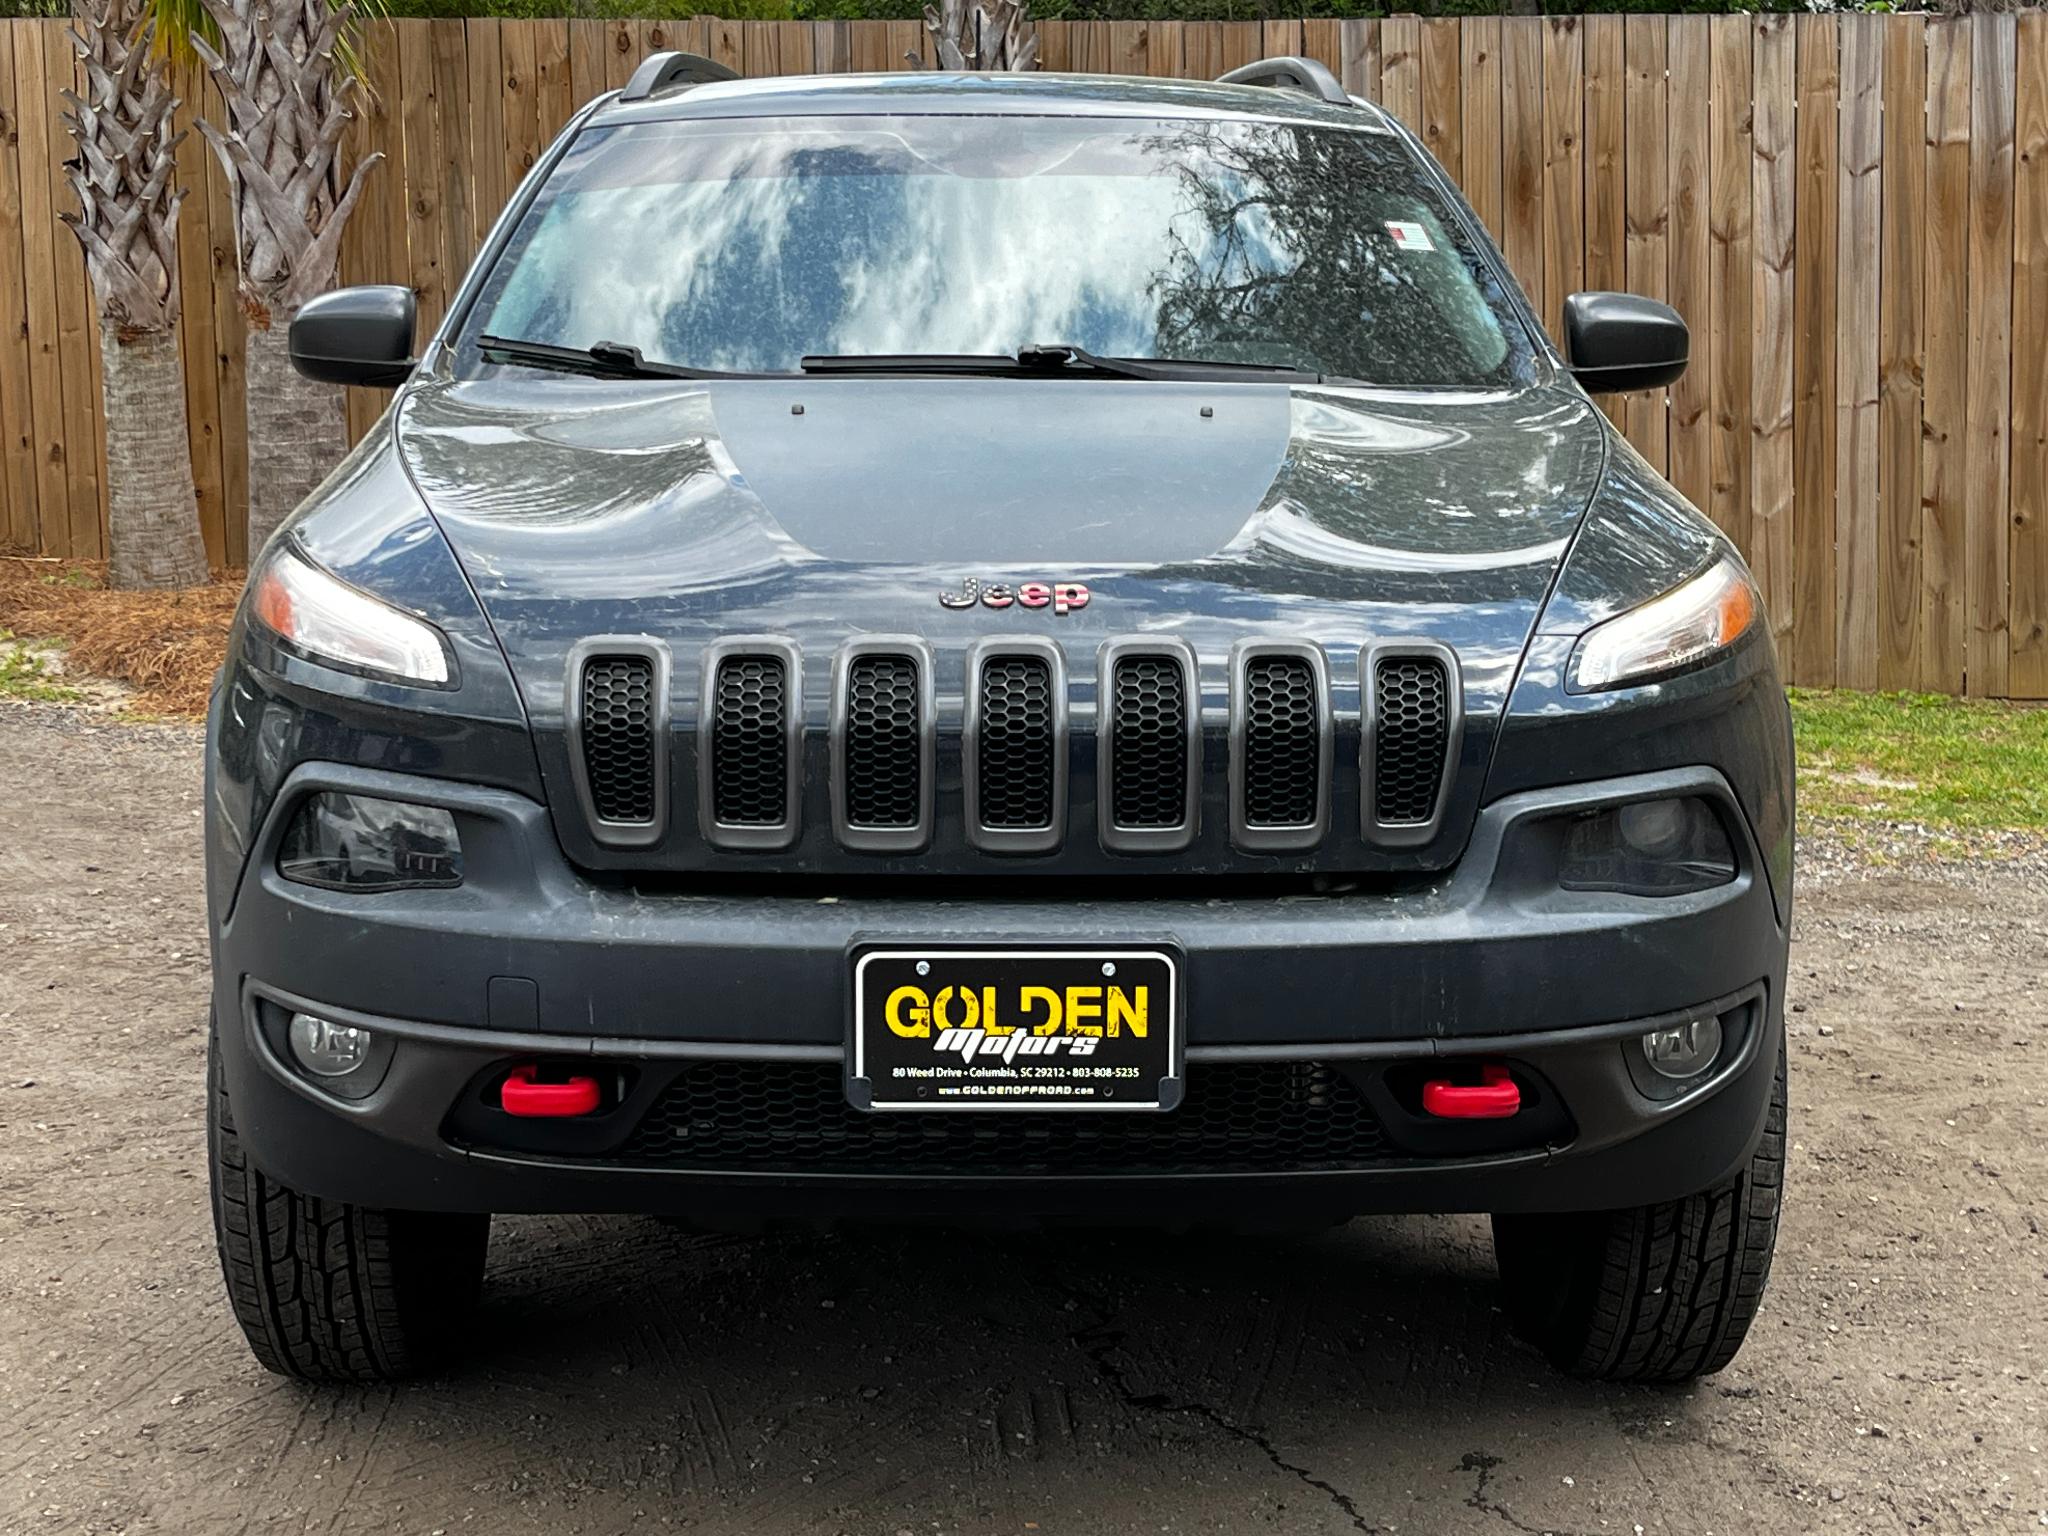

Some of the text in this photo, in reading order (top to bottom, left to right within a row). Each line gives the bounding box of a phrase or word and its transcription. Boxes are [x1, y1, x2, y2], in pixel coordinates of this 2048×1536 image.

[939, 576, 1090, 615] Jeep
[885, 985, 1148, 1038] GOLDEN
[892, 1067, 1140, 1079] 80 Weed Drive Columbia, SC 29212 803-808-5235
